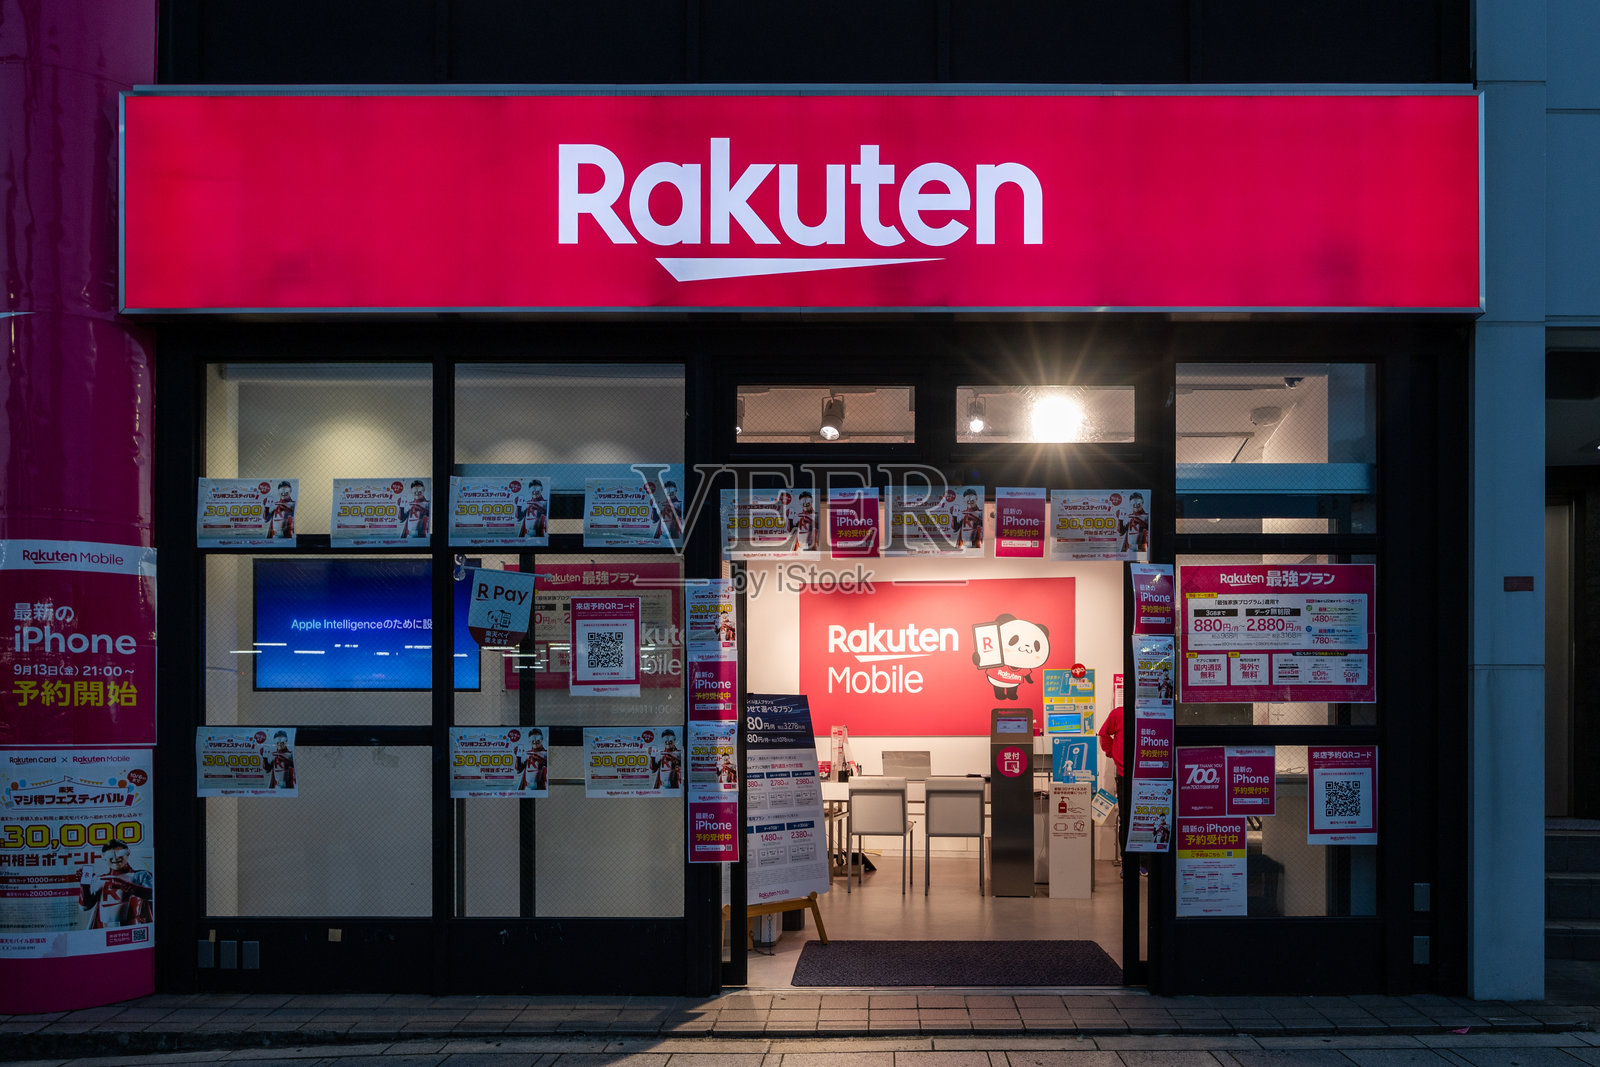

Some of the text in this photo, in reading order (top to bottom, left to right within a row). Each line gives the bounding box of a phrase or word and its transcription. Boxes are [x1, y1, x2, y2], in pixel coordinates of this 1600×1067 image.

[558, 137, 1044, 250] Rakuten
[836, 517, 874, 527] iPhone
[1002, 516, 1040, 526] iPhone
[1002, 529, 1039, 537] 予約受付中
[22, 549, 124, 565] Rakuten Mobile
[1220, 570, 1335, 588] Rakuten 最強プラン
[476, 583, 528, 605] R Pay
[1140, 592, 1171, 603] iPhone
[576, 602, 635, 610] 来店予約QRコード
[1254, 607, 1291, 616] データ無制限
[14, 603, 74, 622] 最新の
[291, 618, 432, 632] Apple Intelligenceのために設
[14, 624, 136, 655] iPhone
[828, 622, 959, 655] Rakuten
[982, 636, 994, 652] R
[1240, 663, 1260, 671] 海外で
[828, 665, 924, 694] Mobile
[997, 669, 1022, 681] Rakuten
[695, 680, 732, 689] iPhone
[12, 680, 138, 707] 予約開始
[695, 692, 732, 700] 予約受付中
[1141, 736, 1169, 747] iPhone
[1004, 752, 1020, 760] 受付
[1140, 750, 1169, 758] 予約受付中
[1312, 751, 1372, 759] 来店予約QRコード
[10, 756, 38, 765] Rakuten
[72, 756, 105, 764] Rakuten
[1233, 774, 1270, 784] iPhone
[1233, 786, 1270, 795] 予約受付中
[14, 793, 124, 806] マジ得フェスティバル
[696, 820, 732, 830] iPhone
[1182, 824, 1241, 833] 最新の iPhone
[4, 821, 142, 849] 30,000
[696, 834, 732, 842] 予約受付中
[1185, 834, 1238, 845] 予約受付中
[0, 852, 102, 867] 円相当ポイント
